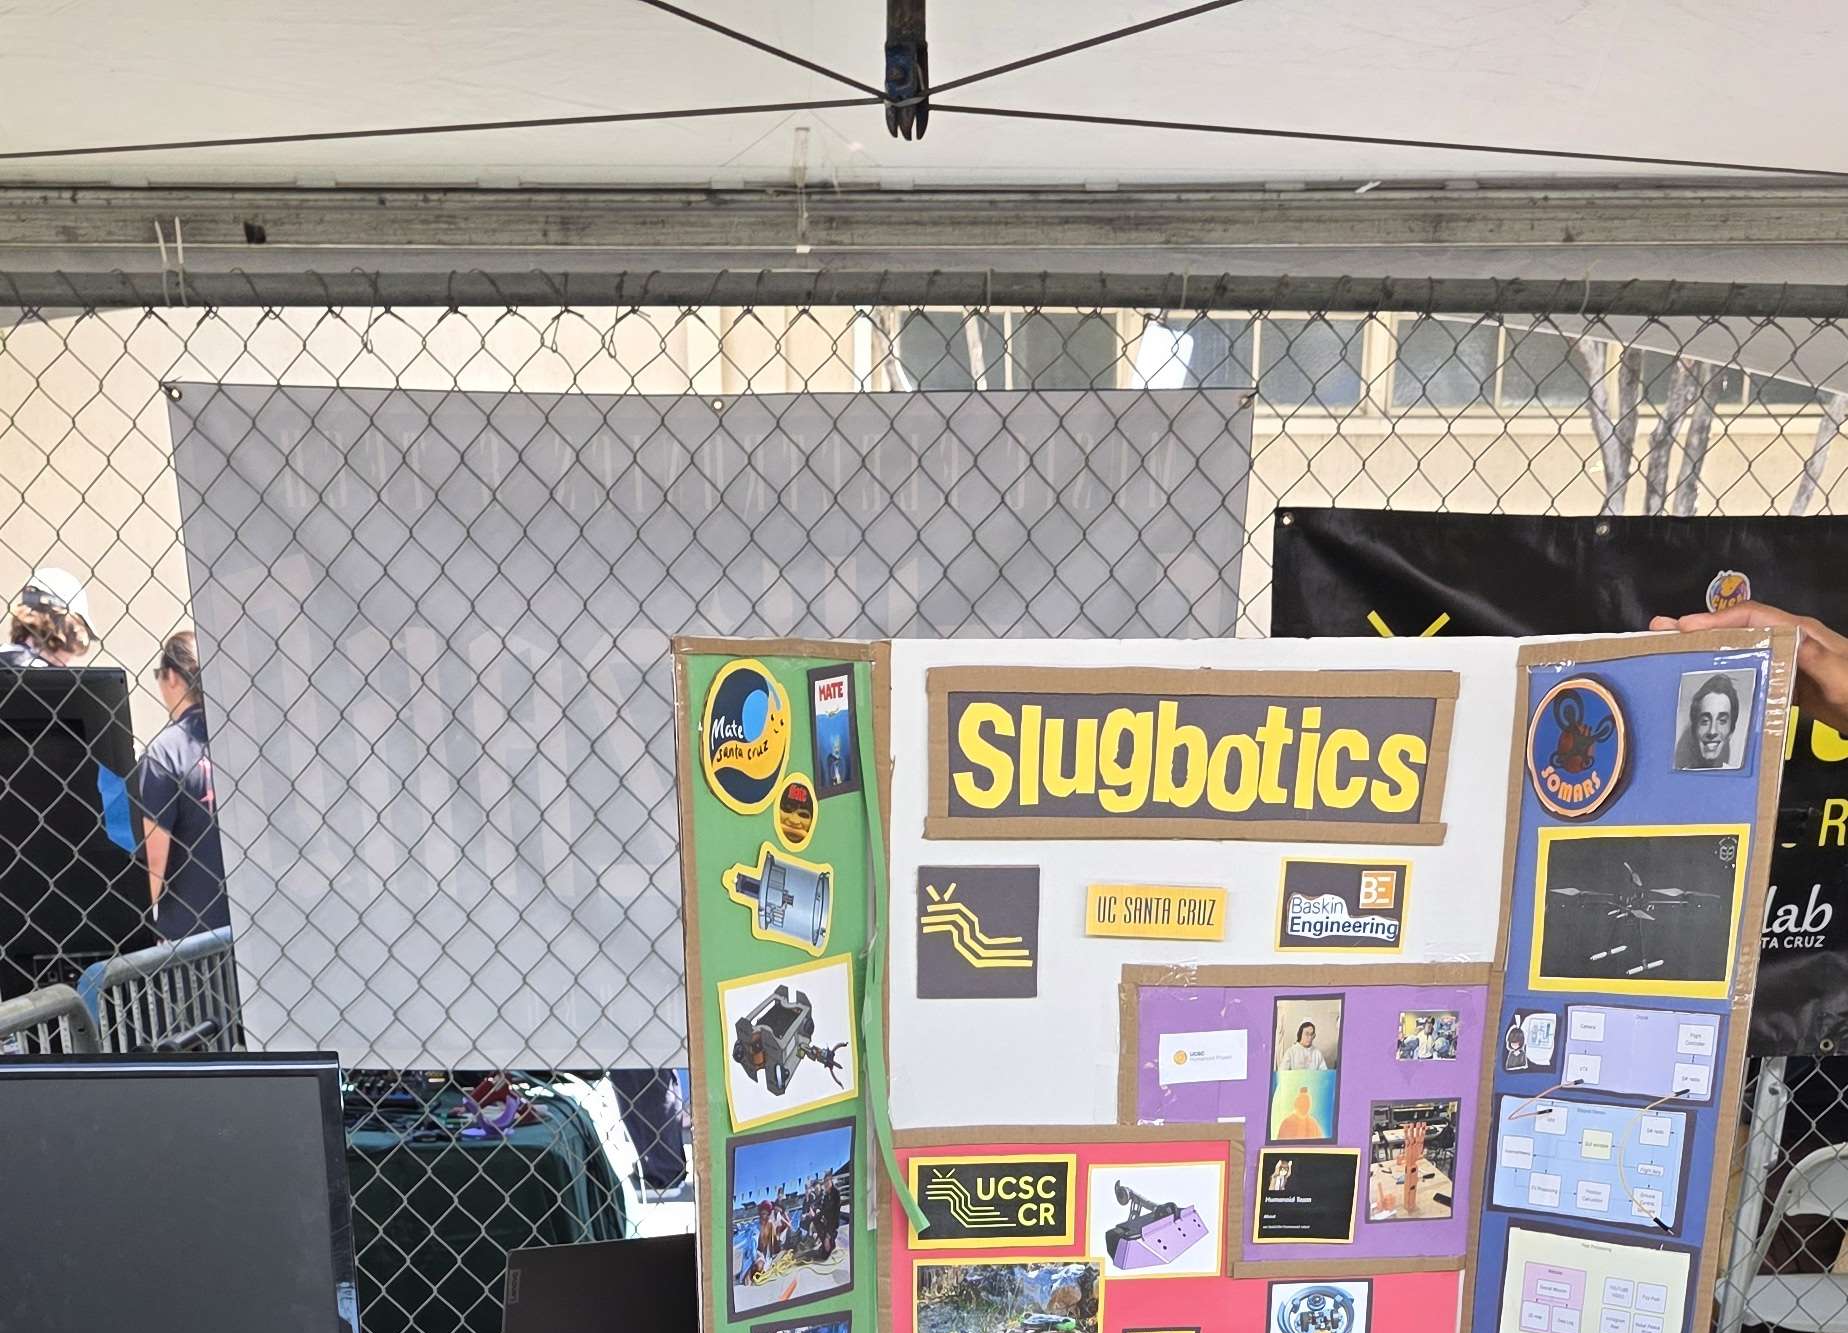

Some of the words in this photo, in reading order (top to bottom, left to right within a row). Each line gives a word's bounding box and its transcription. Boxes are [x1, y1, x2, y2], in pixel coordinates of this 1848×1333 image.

[819, 682, 843, 701] MATE
[711, 716, 743, 749] Mate
[717, 746, 743, 762] santa
[747, 740, 768, 760] cruz
[953, 700, 1427, 813] Slugbotics
[1541, 766, 1601, 803] SOMARS
[1360, 876, 1391, 904] BE
[1097, 898, 1117, 924] UC
[1123, 896, 1172, 925] SANTA
[1178, 898, 1217, 927] CRUZ
[1291, 896, 1344, 915] Baskin
[1290, 916, 1398, 939] Engineering
[1784, 936, 1825, 949] CRUZ
[976, 1174, 1057, 1201] UCSC
[1018, 1202, 1056, 1228] CR
